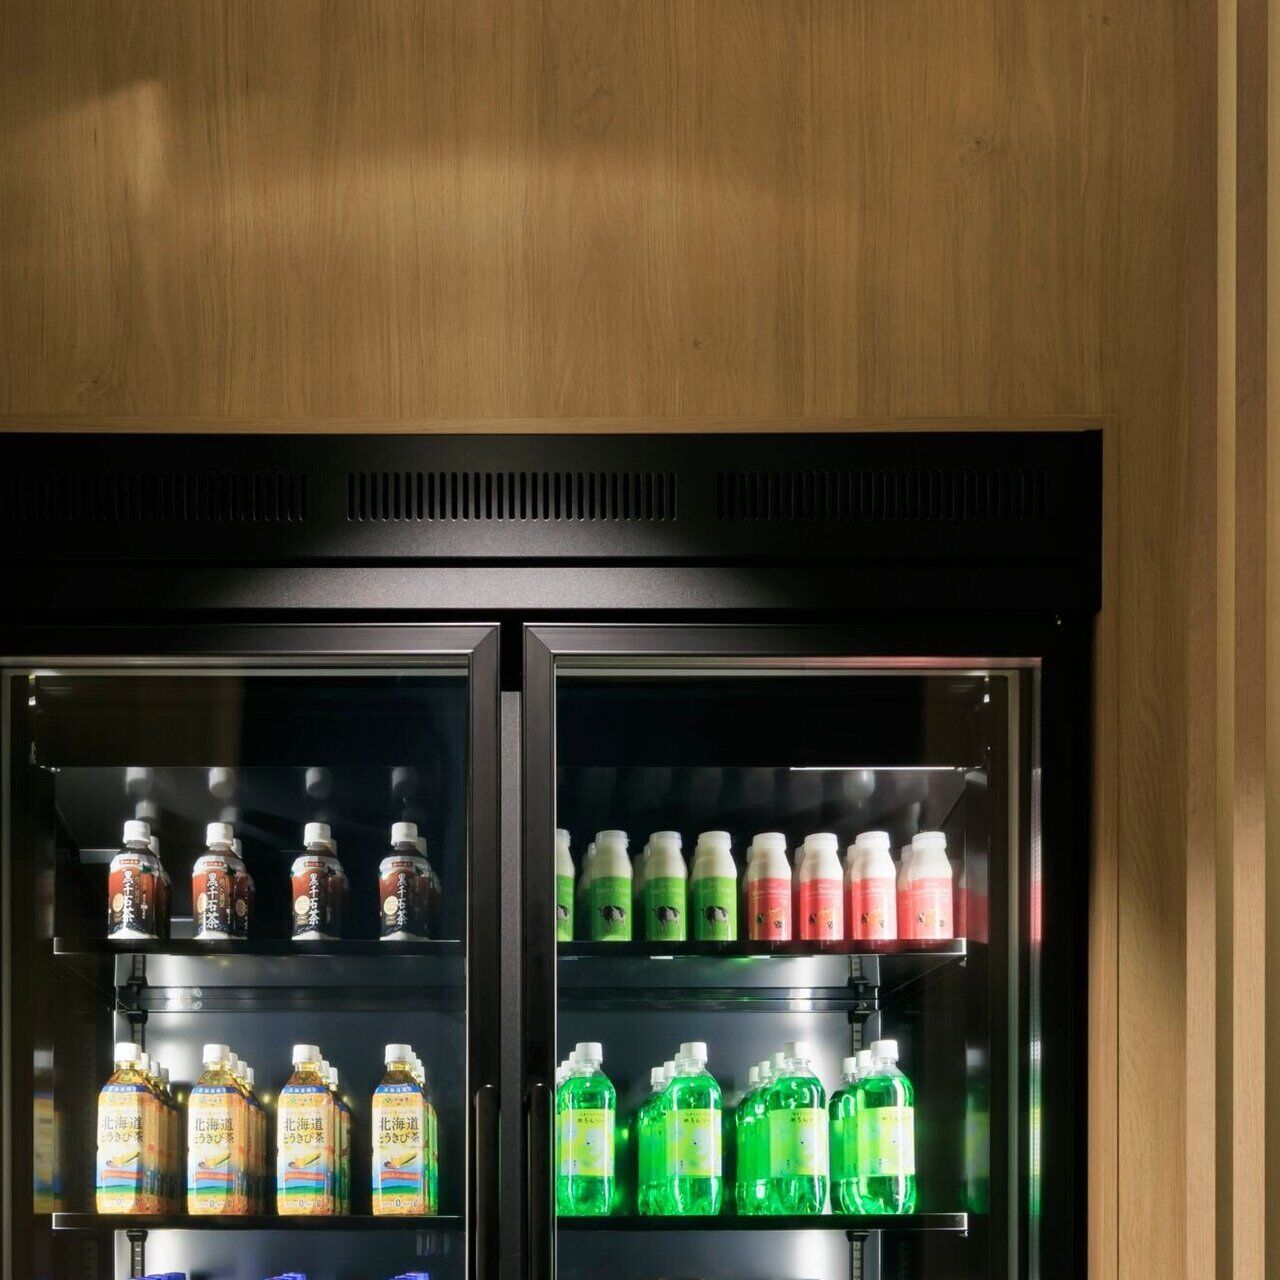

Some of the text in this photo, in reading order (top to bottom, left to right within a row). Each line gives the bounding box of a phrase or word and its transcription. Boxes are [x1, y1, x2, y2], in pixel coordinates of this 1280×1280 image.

[206, 872, 220, 929] 黒千石茶
[307, 872, 320, 926] 黒千石茶
[396, 872, 407, 927] 黒千石茶
[194, 1116, 235, 1132] 北海道
[284, 1116, 324, 1132] 北海道
[380, 1116, 419, 1132] 北海道
